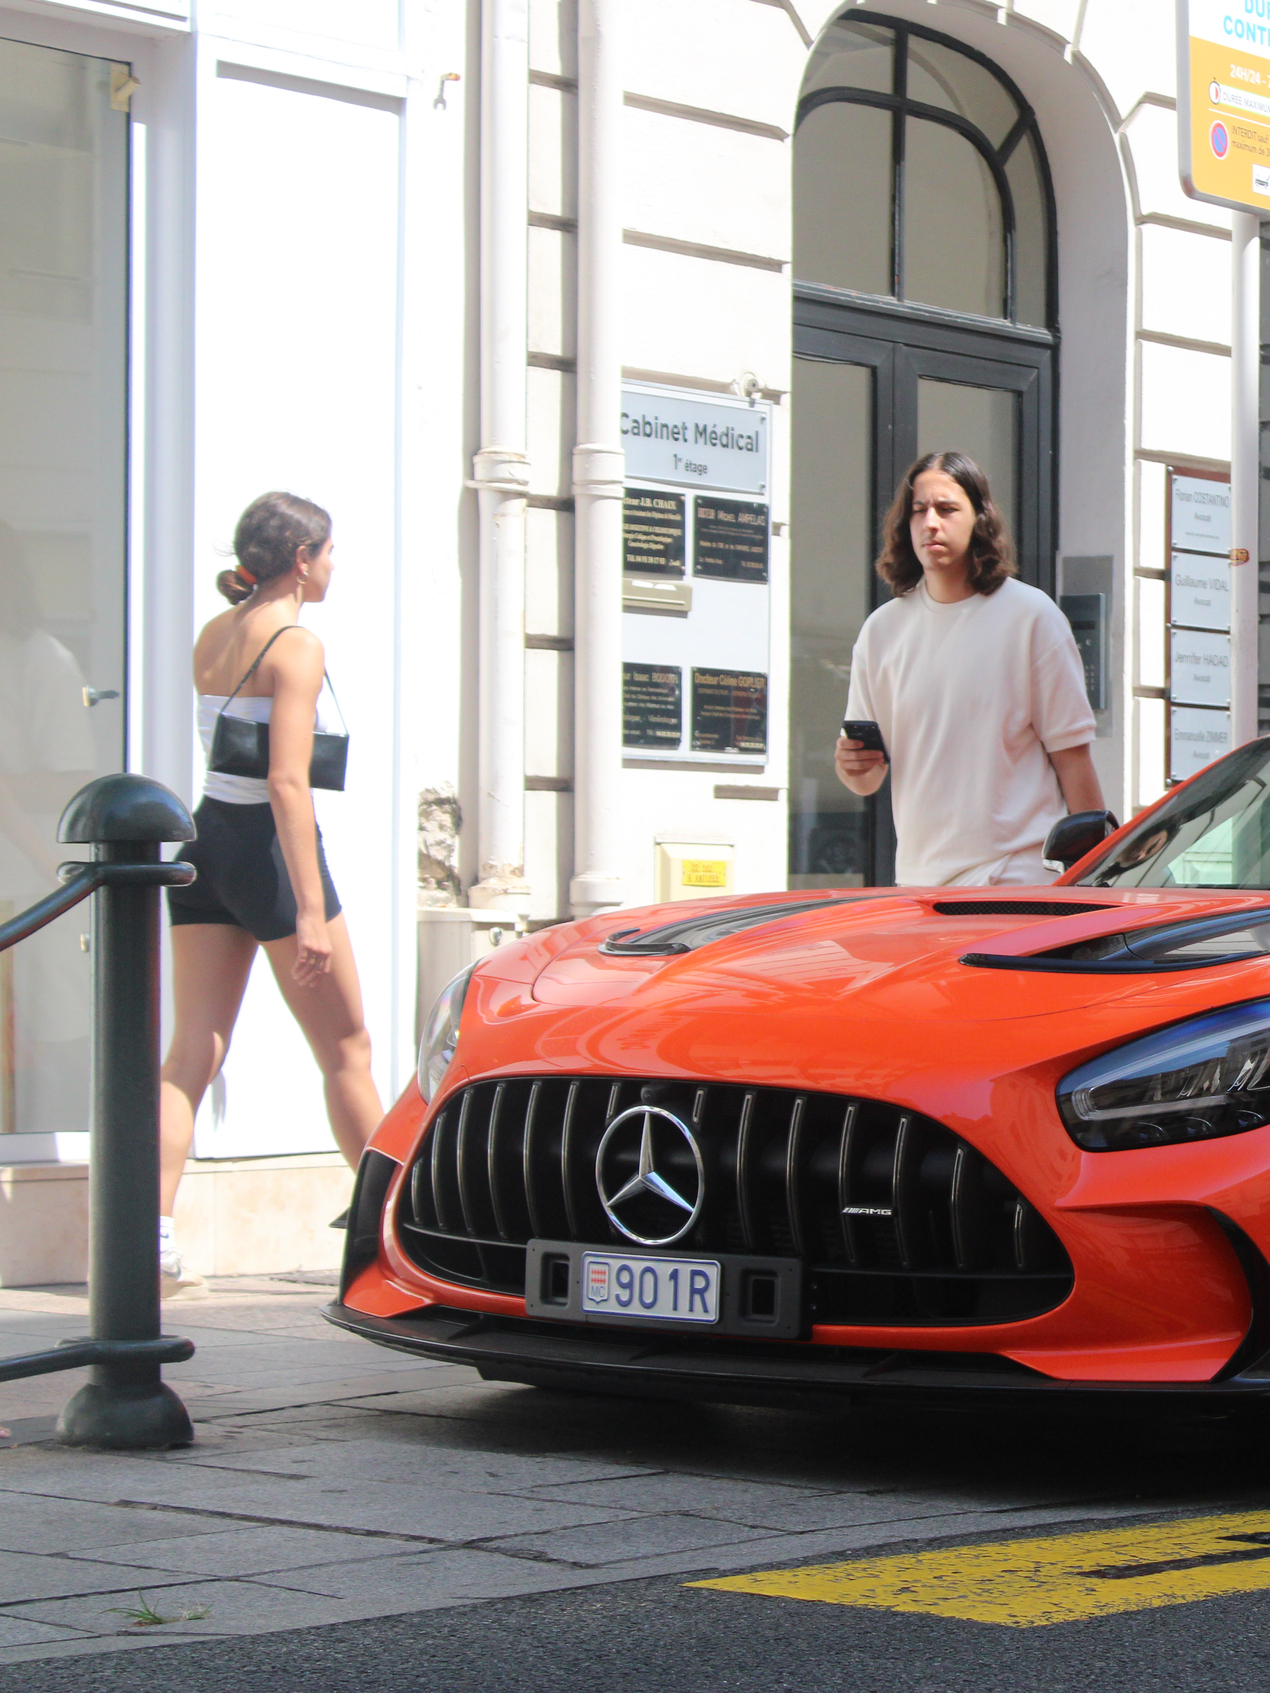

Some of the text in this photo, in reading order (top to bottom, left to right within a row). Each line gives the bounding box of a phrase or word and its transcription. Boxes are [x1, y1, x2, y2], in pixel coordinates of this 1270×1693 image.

[1229, 64, 1261, 85] 24H/24
[1232, 125, 1258, 140] INTERDIT
[1232, 140, 1257, 152] maximum
[620, 412, 759, 453] Cabinet Médical
[685, 459, 708, 476] étage
[1175, 573, 1230, 592] Guillaume VIDAL
[1175, 651, 1201, 664] Jennifer
[1174, 728, 1205, 742] Emmanuelle
[858, 1207, 892, 1216] AMG
[591, 1285, 606, 1299] MC
